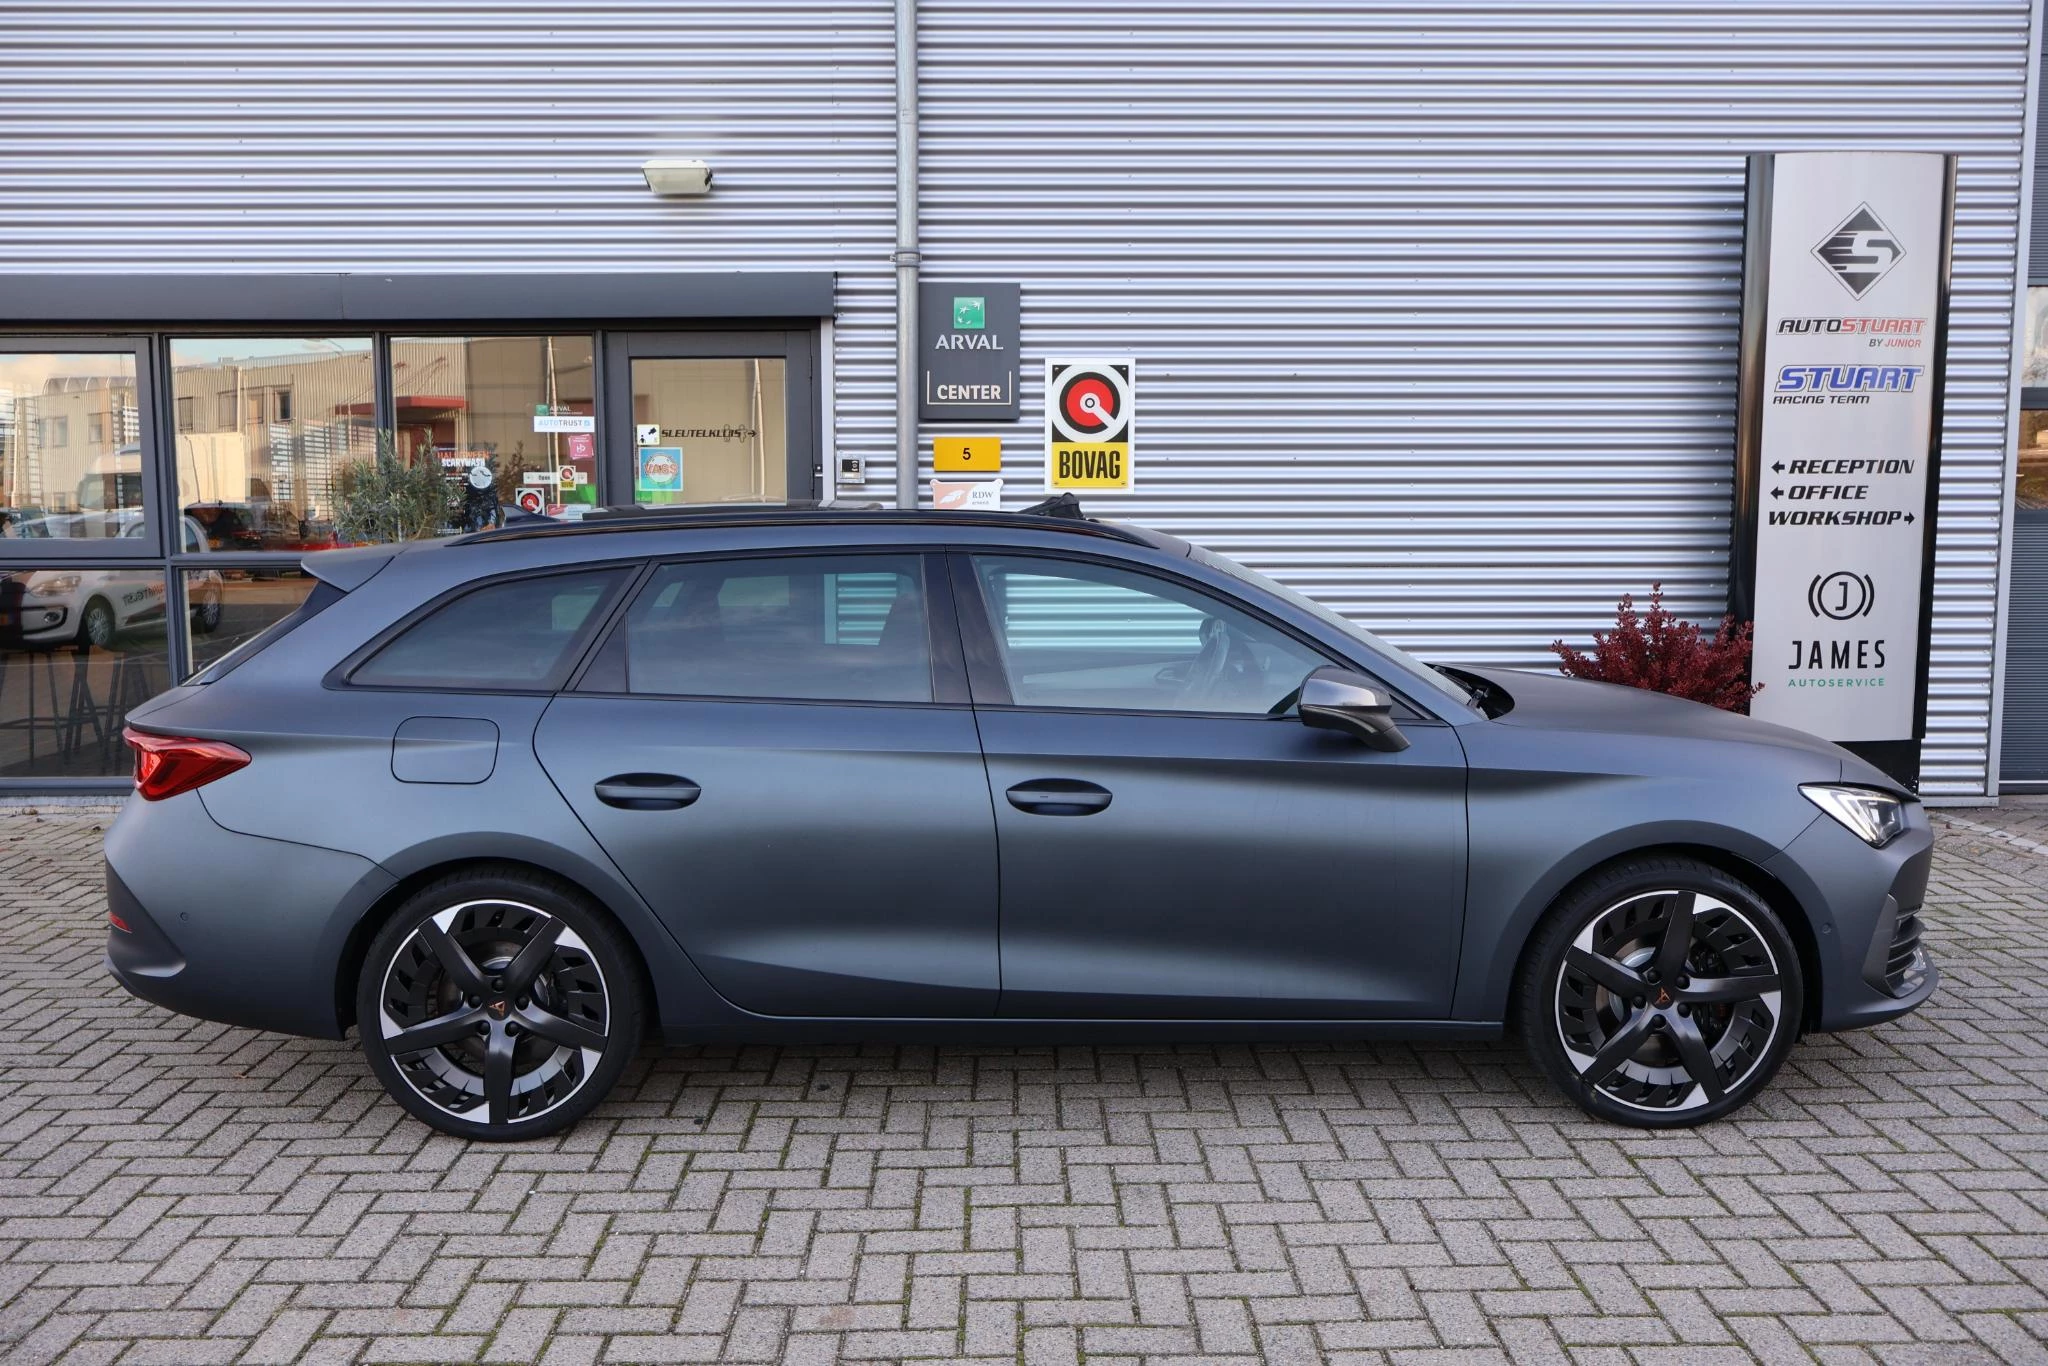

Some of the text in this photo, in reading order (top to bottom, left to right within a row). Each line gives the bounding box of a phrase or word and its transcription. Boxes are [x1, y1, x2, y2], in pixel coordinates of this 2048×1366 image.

[1777, 318, 1927, 334] AUTOSTUART
[935, 334, 1004, 350] ARVAL
[1869, 338, 1922, 348] BY JUNIOR
[1777, 366, 1923, 390] STUART
[937, 384, 1001, 400] CENTER
[1772, 395, 1870, 404] RACING TEAM
[538, 419, 582, 427] AUTOTRUST
[661, 429, 741, 438] SLEUTELKLUIS
[962, 448, 971, 461] 5
[1058, 450, 1121, 479] BOVAG
[1788, 459, 1915, 474] RECEPTION
[972, 491, 994, 499] RDW
[1788, 485, 1869, 500] OFFICE
[1768, 511, 1902, 526] WORKSHOP
[1788, 639, 1886, 670] JAMES
[1788, 678, 1885, 688] AUTOSERVICE
